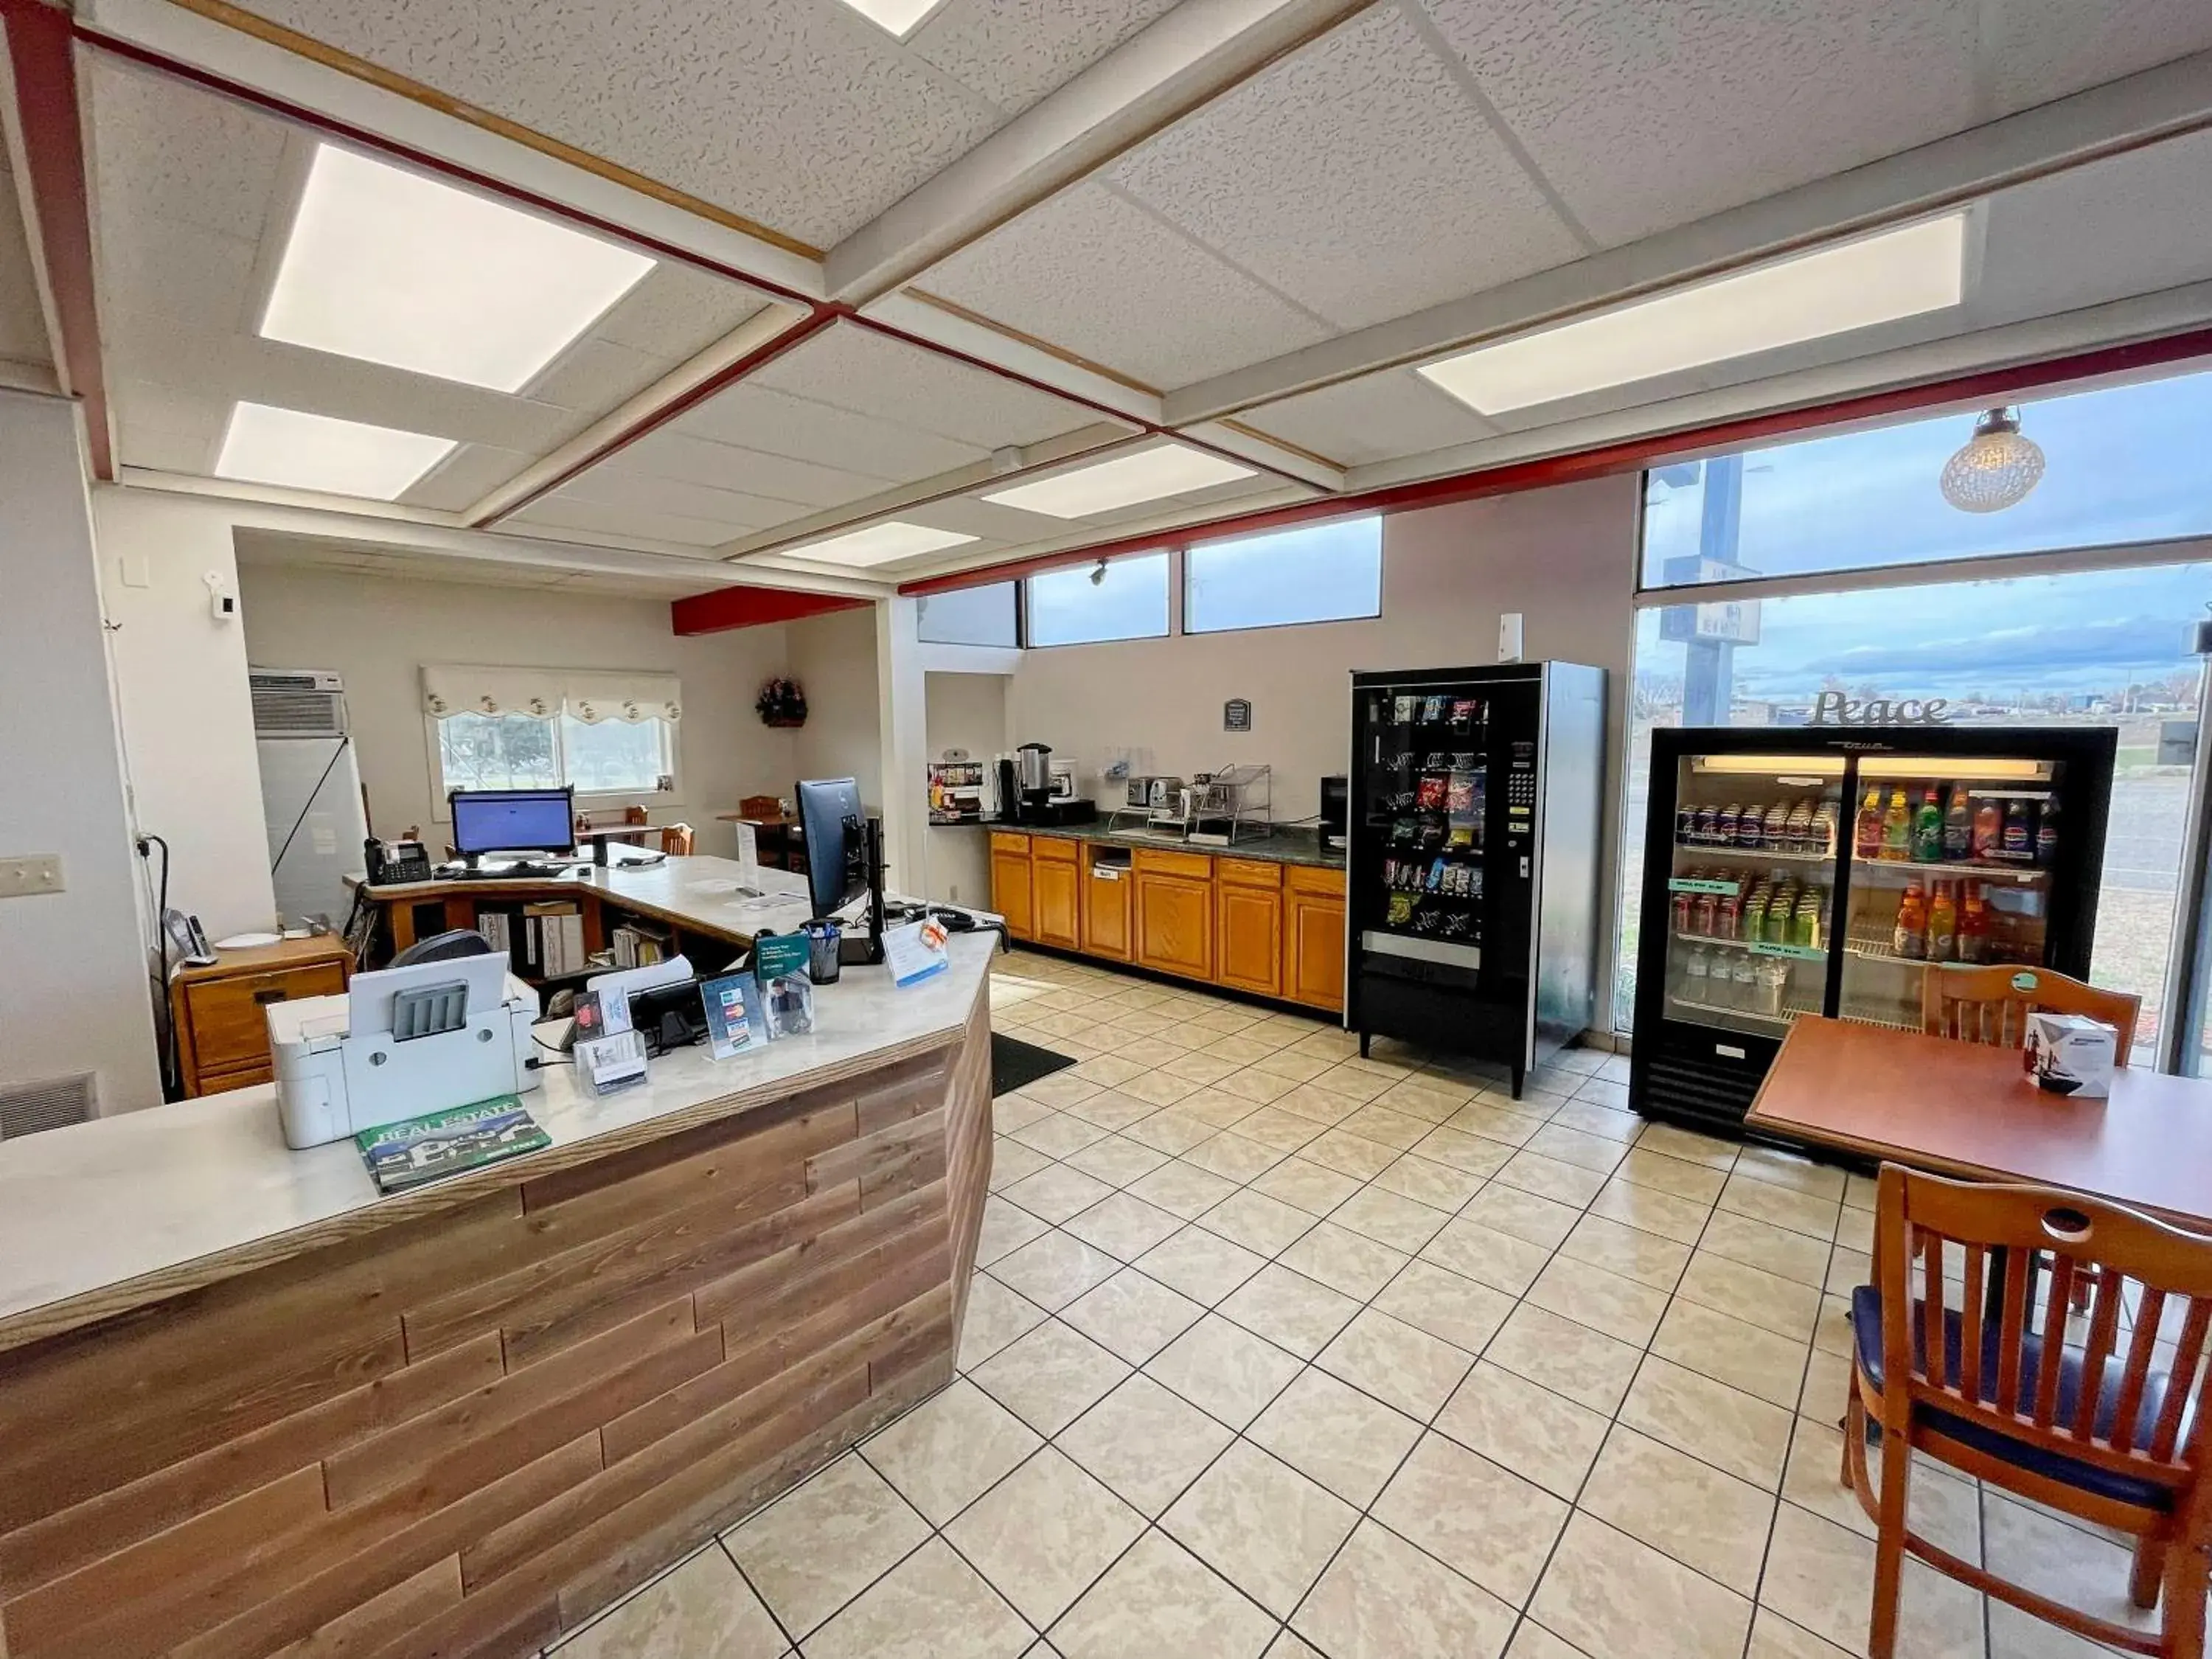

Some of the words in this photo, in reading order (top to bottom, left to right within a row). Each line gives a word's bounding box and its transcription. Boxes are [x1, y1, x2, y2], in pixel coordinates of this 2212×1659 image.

[1809, 690, 1950, 726] Peace
[378, 1121, 436, 1142] REAL
[442, 1102, 515, 1127] ESTATE
